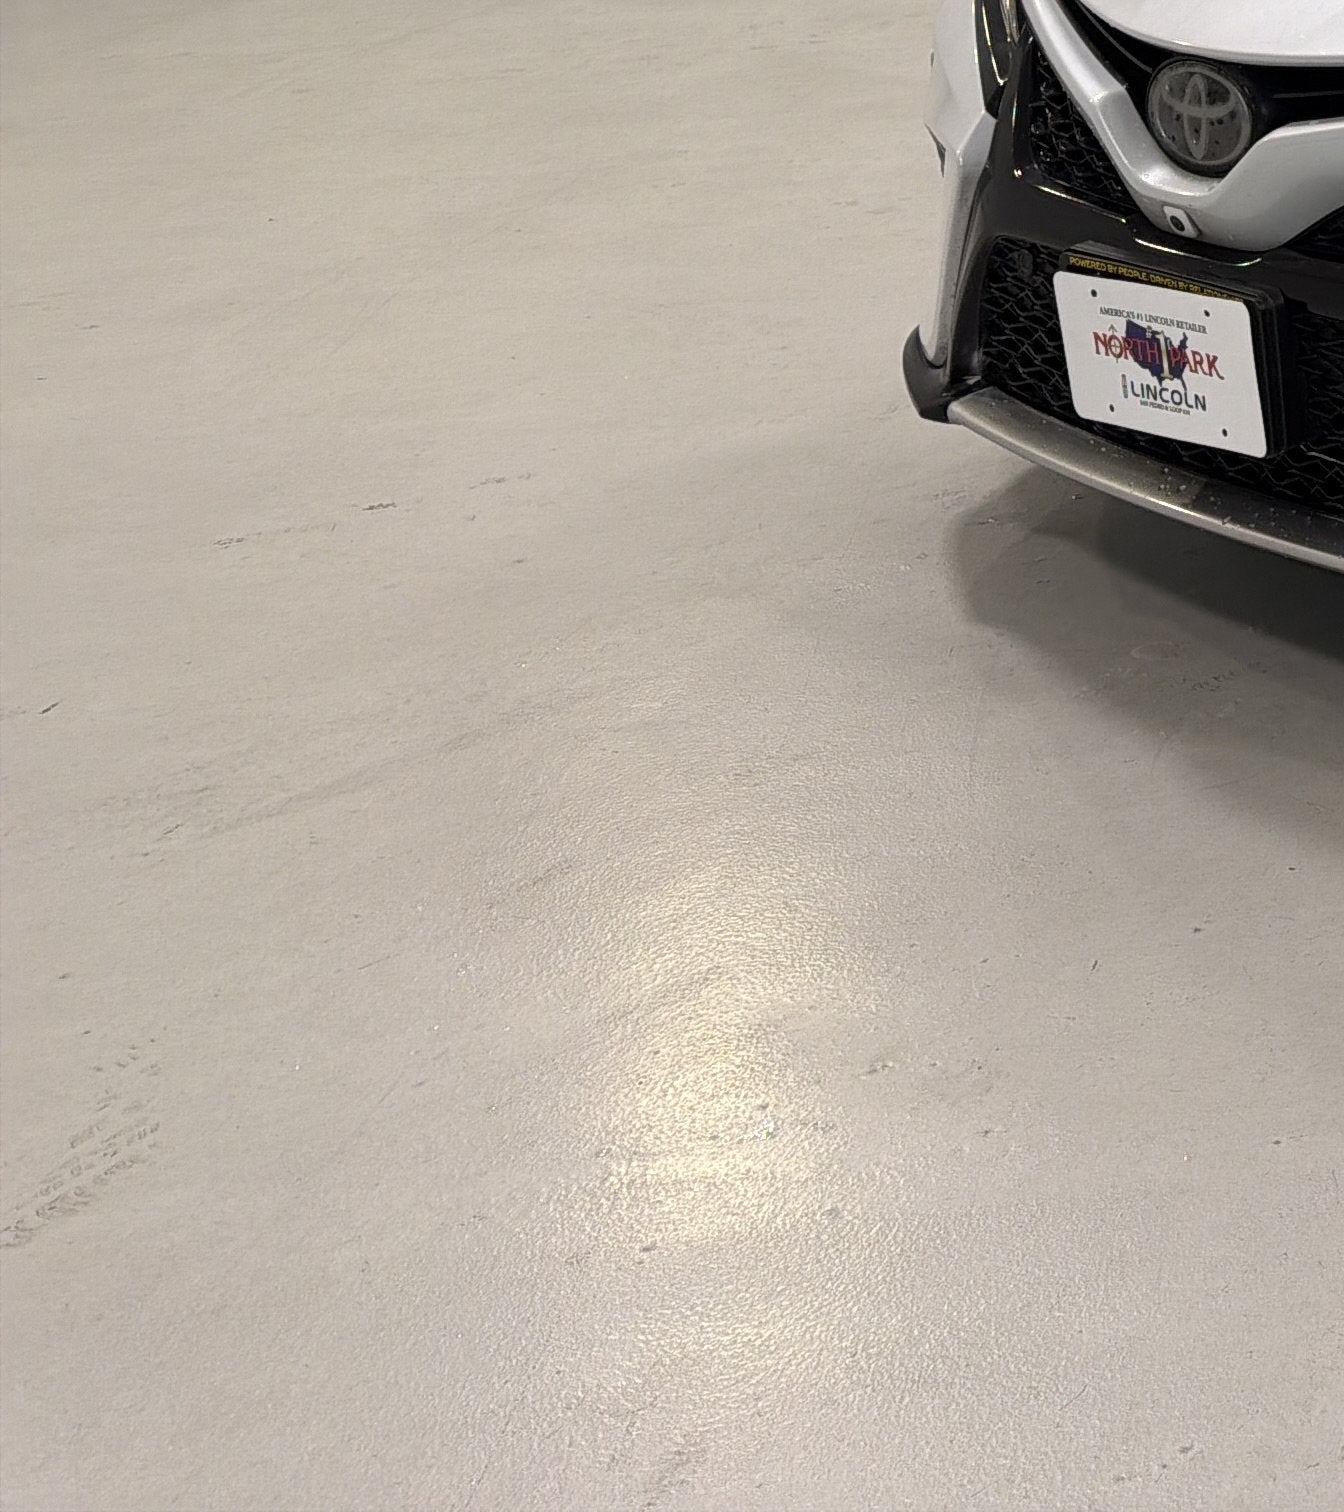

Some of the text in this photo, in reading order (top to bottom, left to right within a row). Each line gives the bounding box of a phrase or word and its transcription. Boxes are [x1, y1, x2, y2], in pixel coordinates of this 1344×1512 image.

[1069, 256, 1107, 272] POWERED
[1107, 264, 1118, 274] BY
[1099, 306, 1135, 320] AMERICA'S
[1144, 313, 1175, 328] LINCOLN
[1176, 320, 1208, 334] RETAILER
[1092, 331, 1225, 381] NORTH PARK
[1130, 380, 1207, 412] LINCOLN
